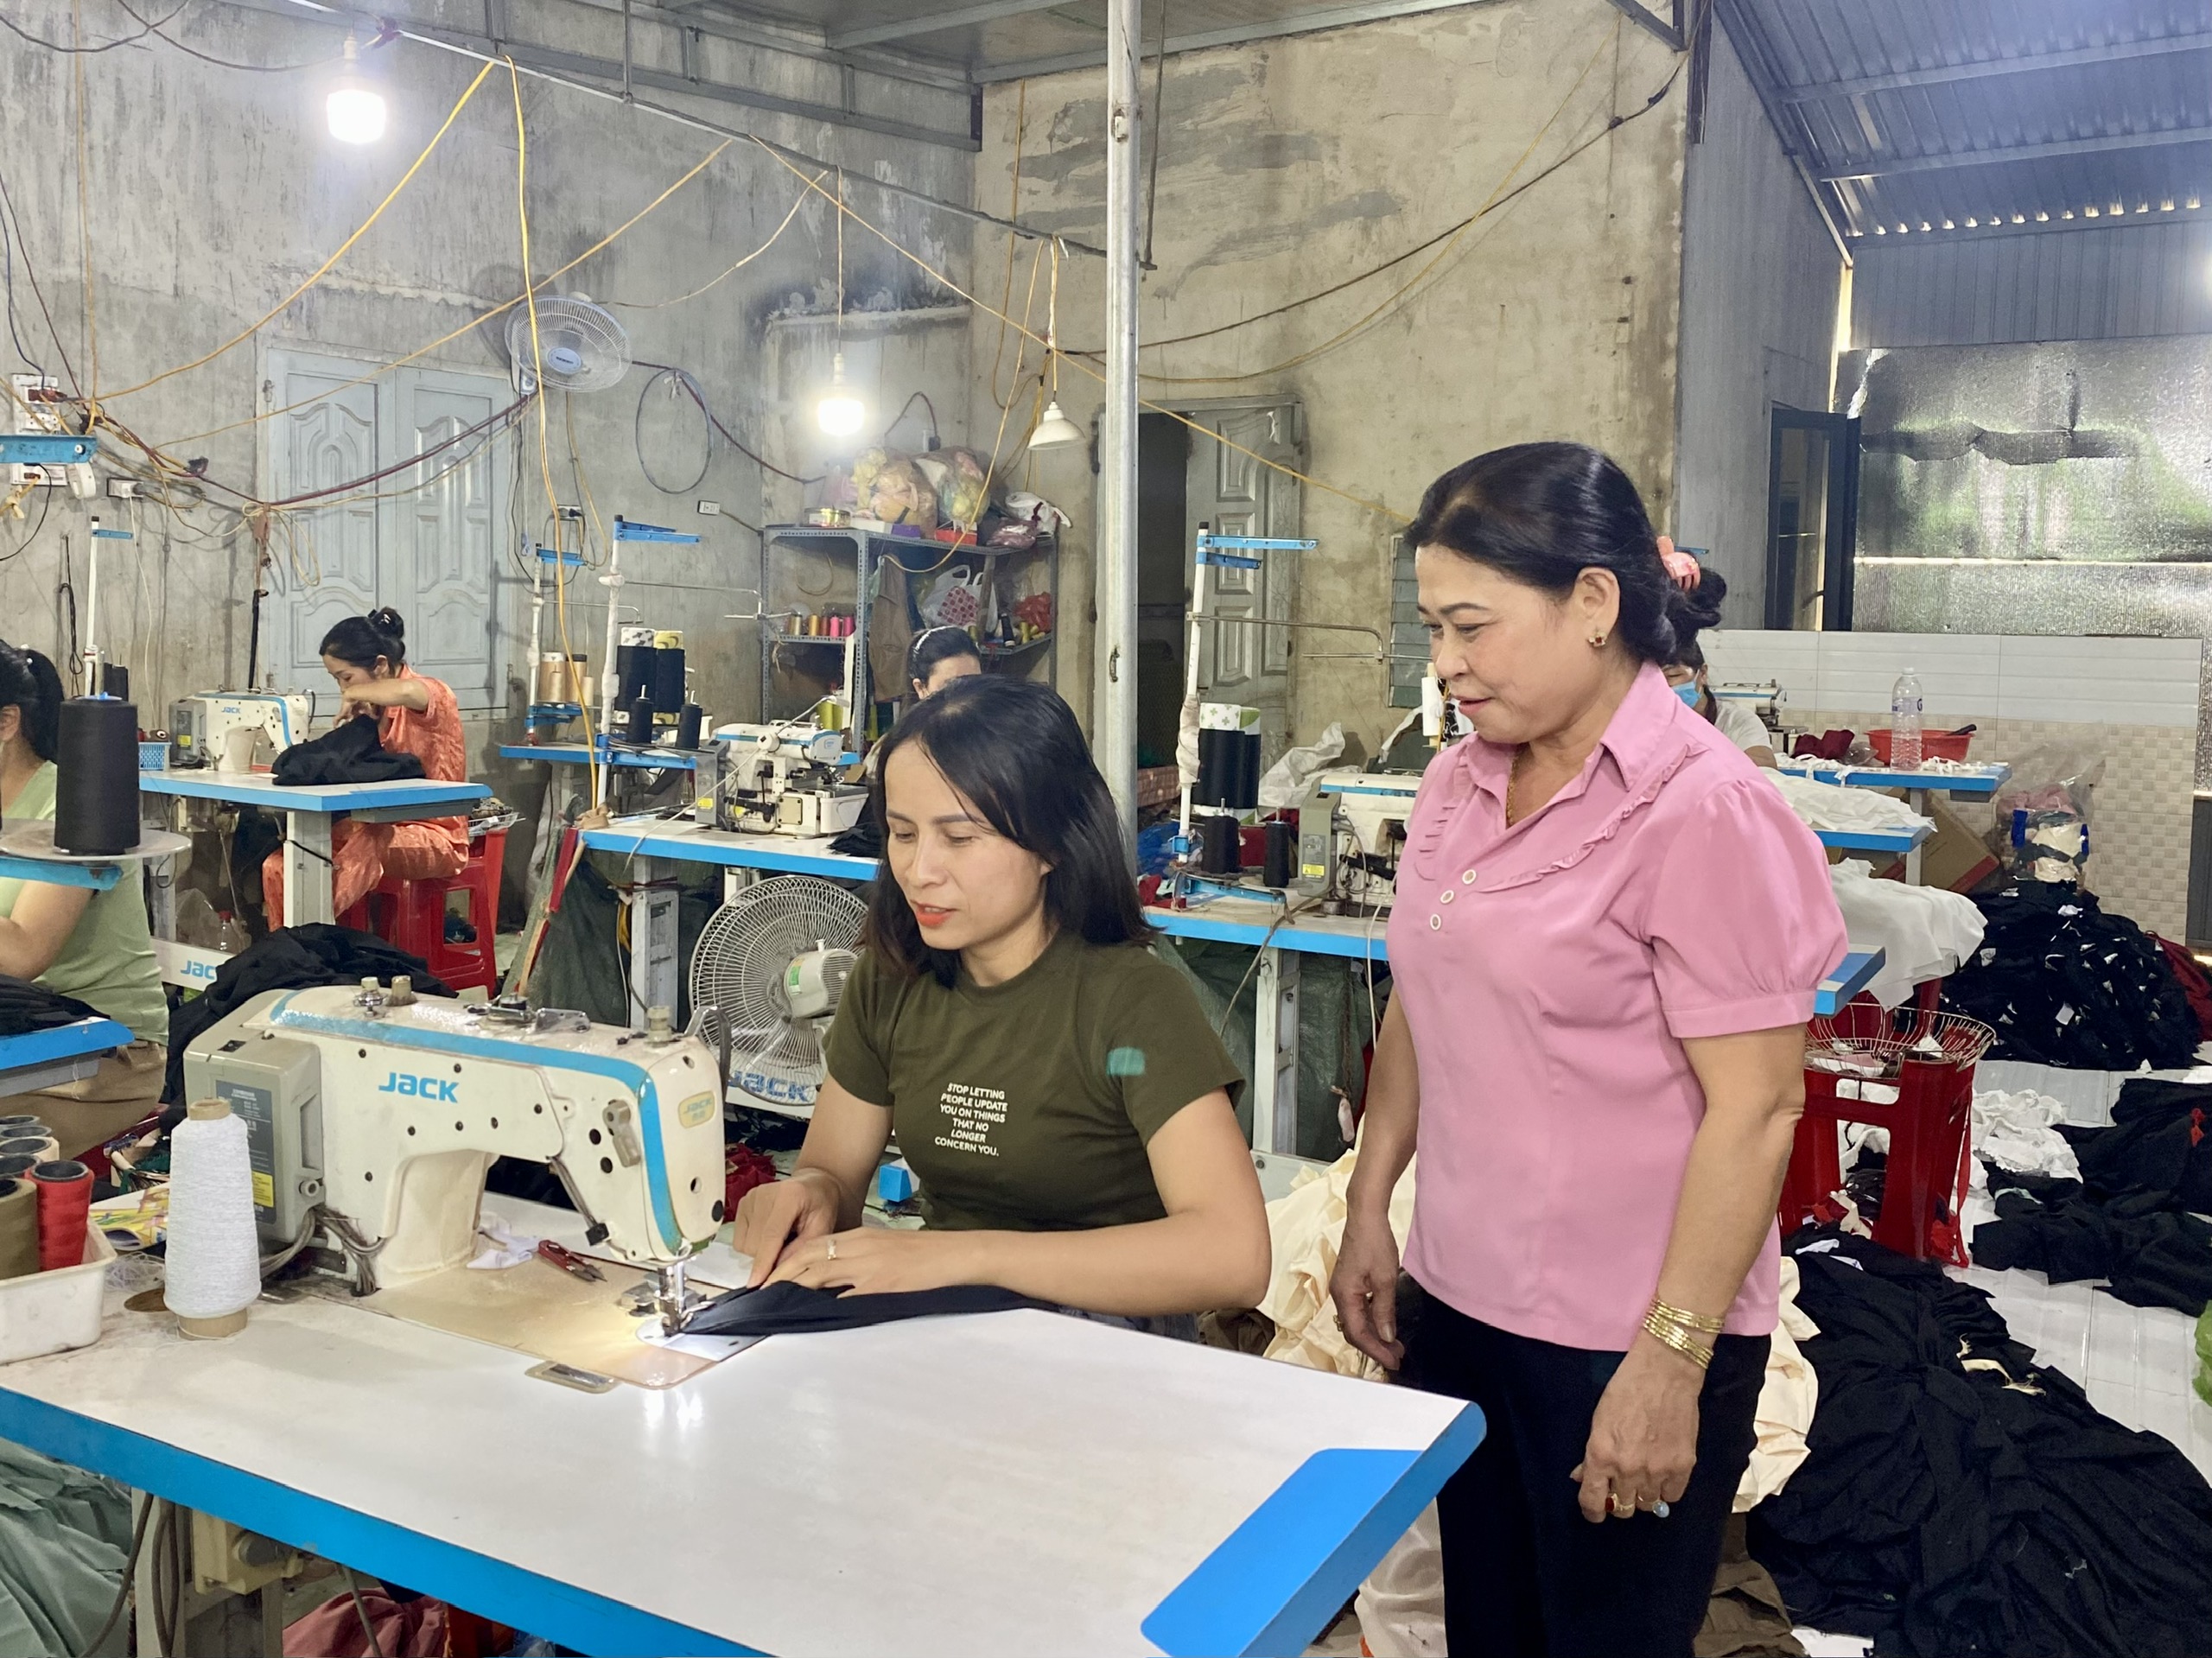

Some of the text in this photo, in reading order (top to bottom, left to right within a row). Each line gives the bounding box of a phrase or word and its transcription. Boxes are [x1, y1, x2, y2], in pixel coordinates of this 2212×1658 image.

[947, 1083, 1005, 1100] STOP LETTING
[941, 1093, 1007, 1112] PEOPLE UPDATE
[940, 1103, 1005, 1123] YOU ON THINGS
[953, 1118, 988, 1132] THAT NO
[951, 1129, 986, 1142] LONGER
[935, 1137, 999, 1156] CONCERN YOU.
